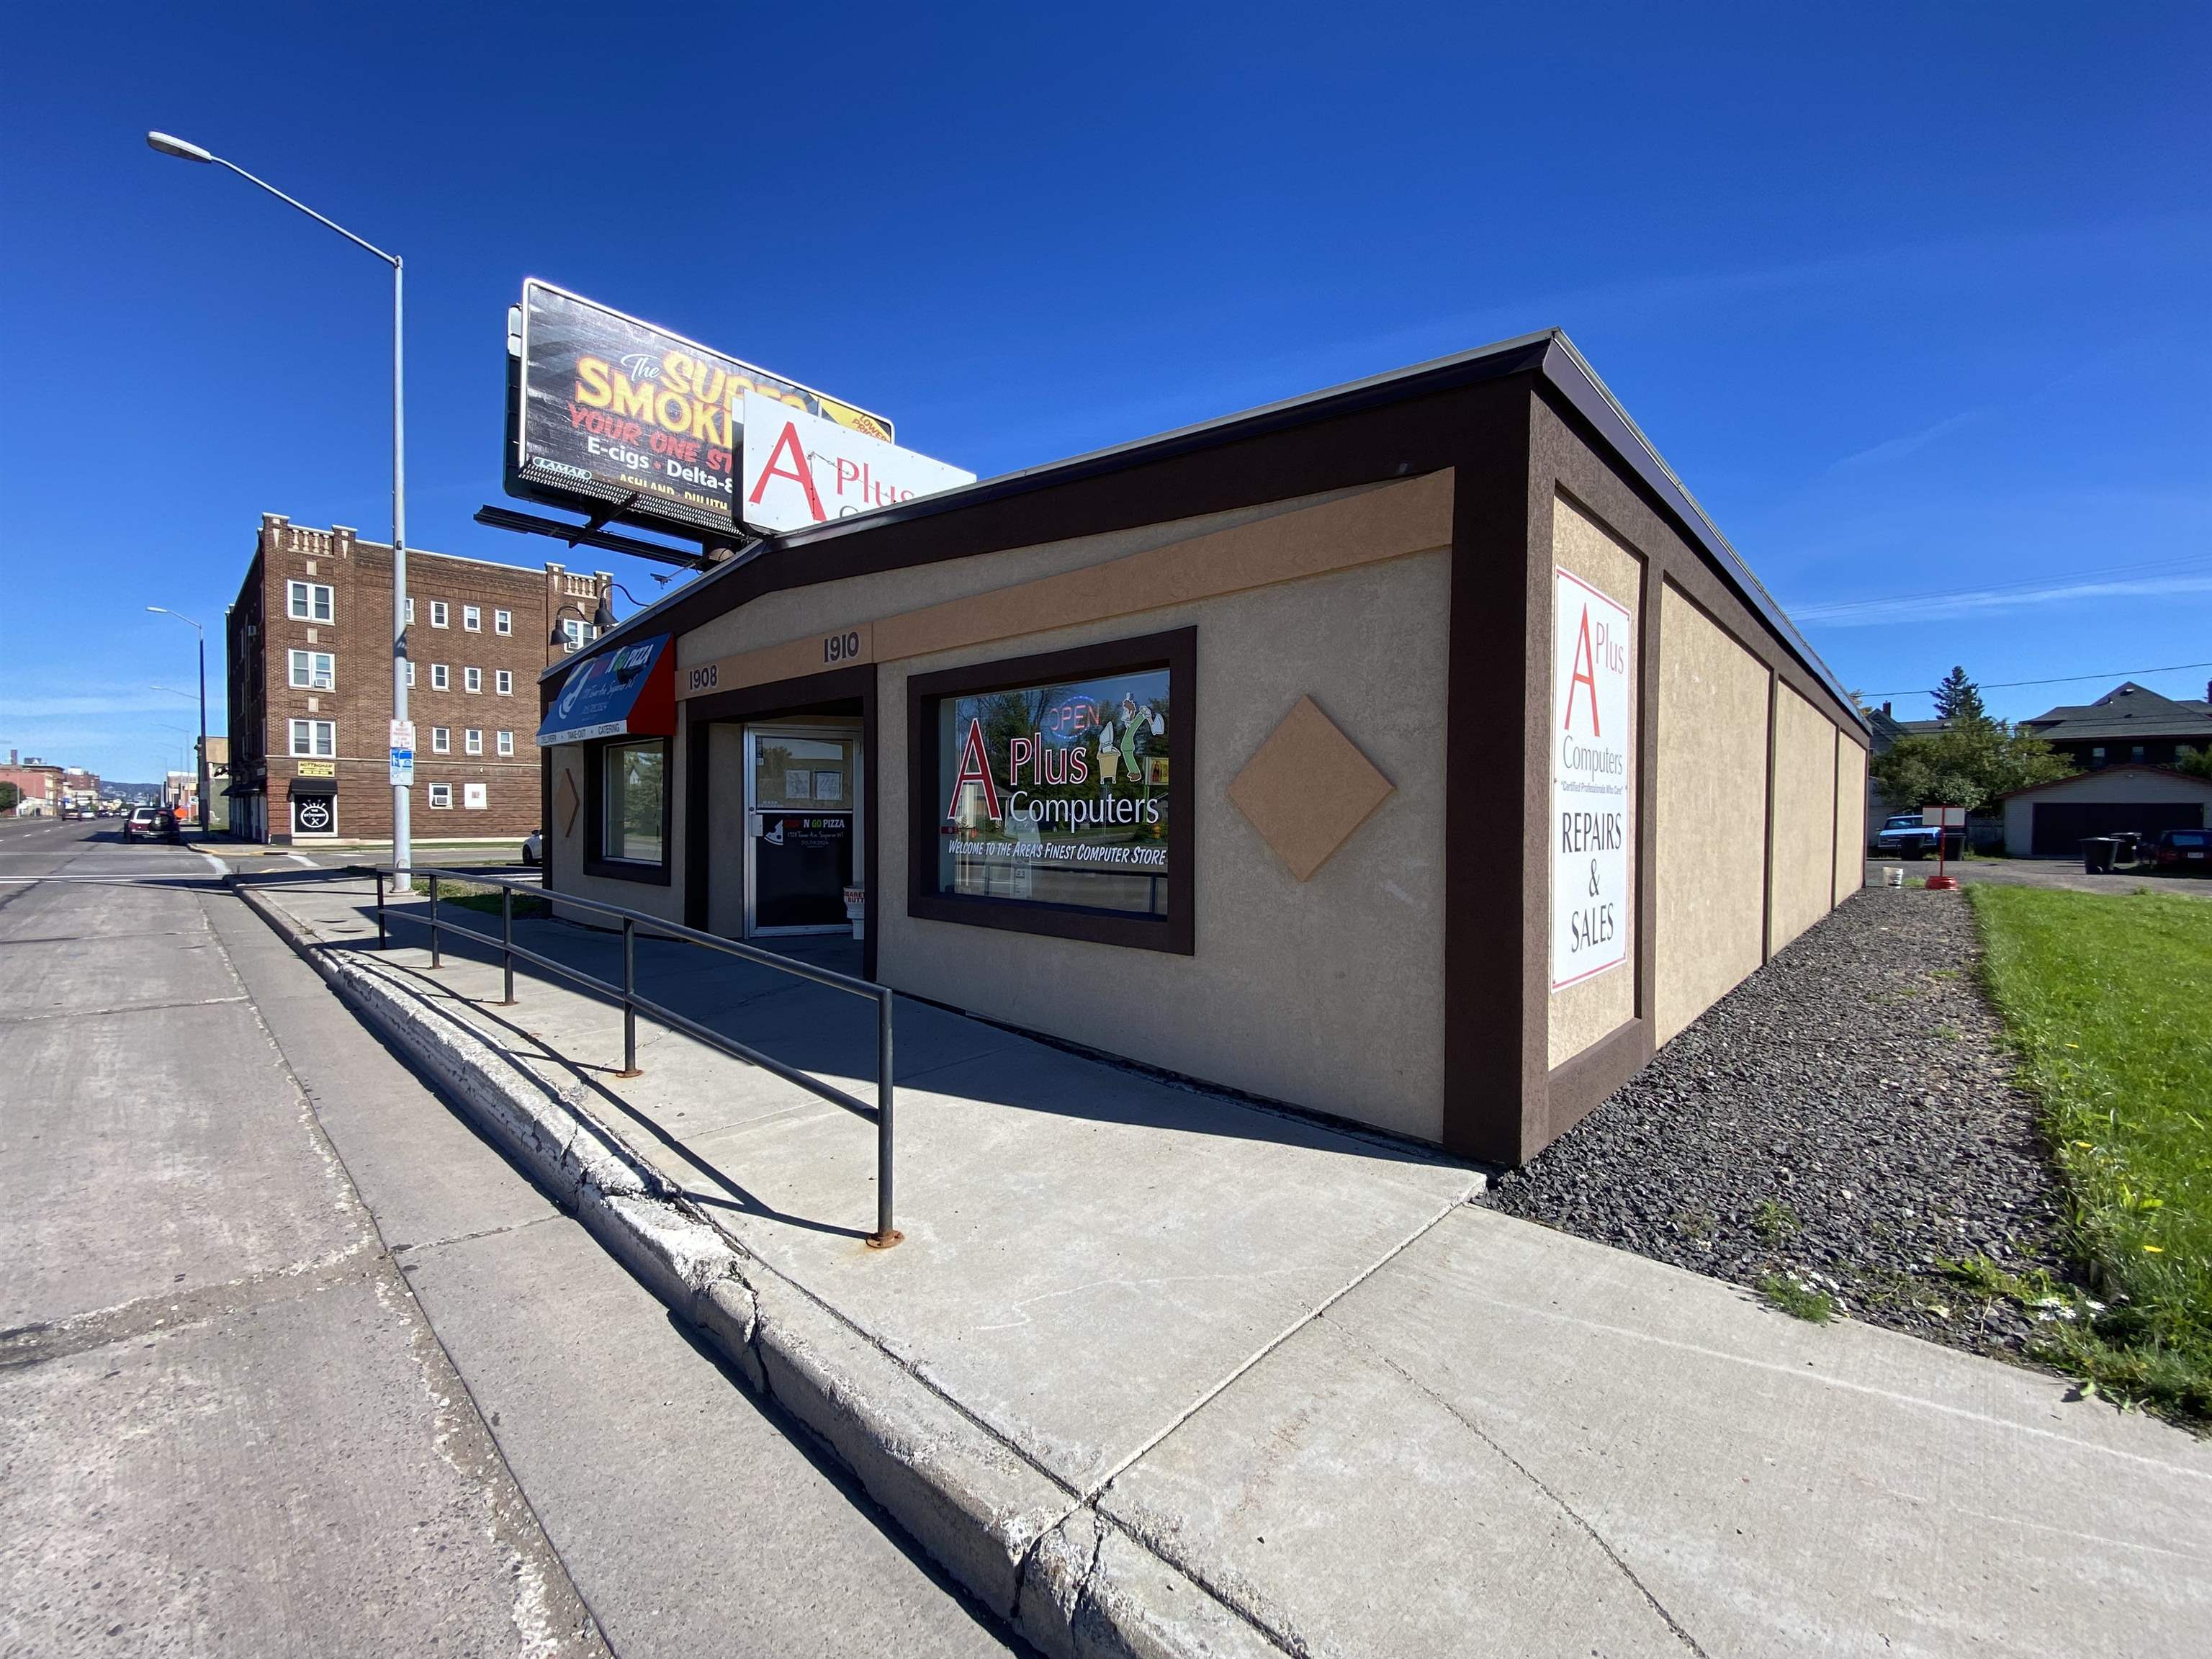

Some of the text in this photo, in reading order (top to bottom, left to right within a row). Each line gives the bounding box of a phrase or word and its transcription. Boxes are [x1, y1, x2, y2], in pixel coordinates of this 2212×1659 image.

[621, 350, 807, 411] The SUP
[568, 402, 642, 446] YOUR
[649, 431, 699, 462] ONE
[539, 459, 585, 479] LAMAR
[588, 436, 649, 469] E-cigs
[749, 421, 827, 522] A
[624, 644, 655, 669] PIZZA
[824, 631, 860, 663] 1910
[690, 665, 717, 691] 1908
[1563, 602, 1624, 738] A Plus
[567, 729, 586, 739] TAKE-OUT
[598, 722, 620, 735] CATERING
[1048, 704, 1100, 731] OPEN
[947, 717, 1088, 822] A Plus
[1563, 734, 1624, 782] Computers
[803, 819, 810, 828] N
[811, 819, 822, 828] GO
[822, 819, 845, 828] PIZZA
[1010, 791, 1160, 834] Computers
[1562, 812, 1622, 853] REPAIRS
[948, 839, 1167, 865] WELCOME TO THE AREA'S FINEST COMPUTER STORE
[1588, 858, 1601, 898] &
[1571, 902, 1614, 953] SALES
